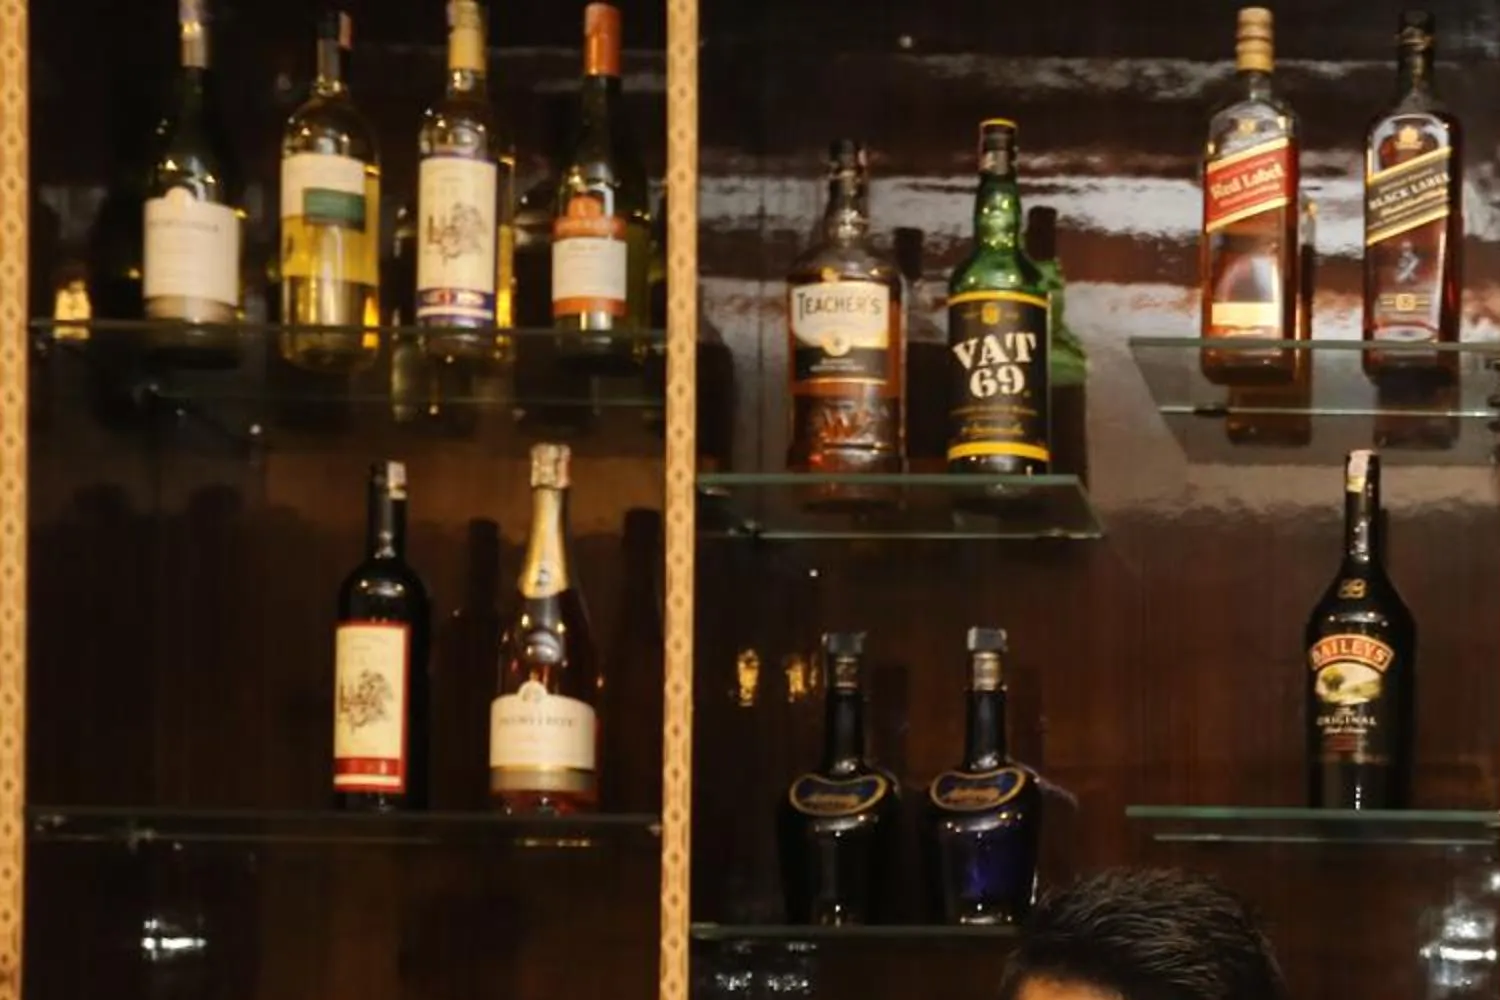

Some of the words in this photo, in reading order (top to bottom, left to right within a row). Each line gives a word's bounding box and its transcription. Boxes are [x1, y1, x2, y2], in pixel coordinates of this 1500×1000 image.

[1368, 187, 1410, 211] BLACK
[796, 291, 883, 321] TEACHER'S
[952, 331, 1037, 370] VAT
[969, 364, 1026, 398] 69
